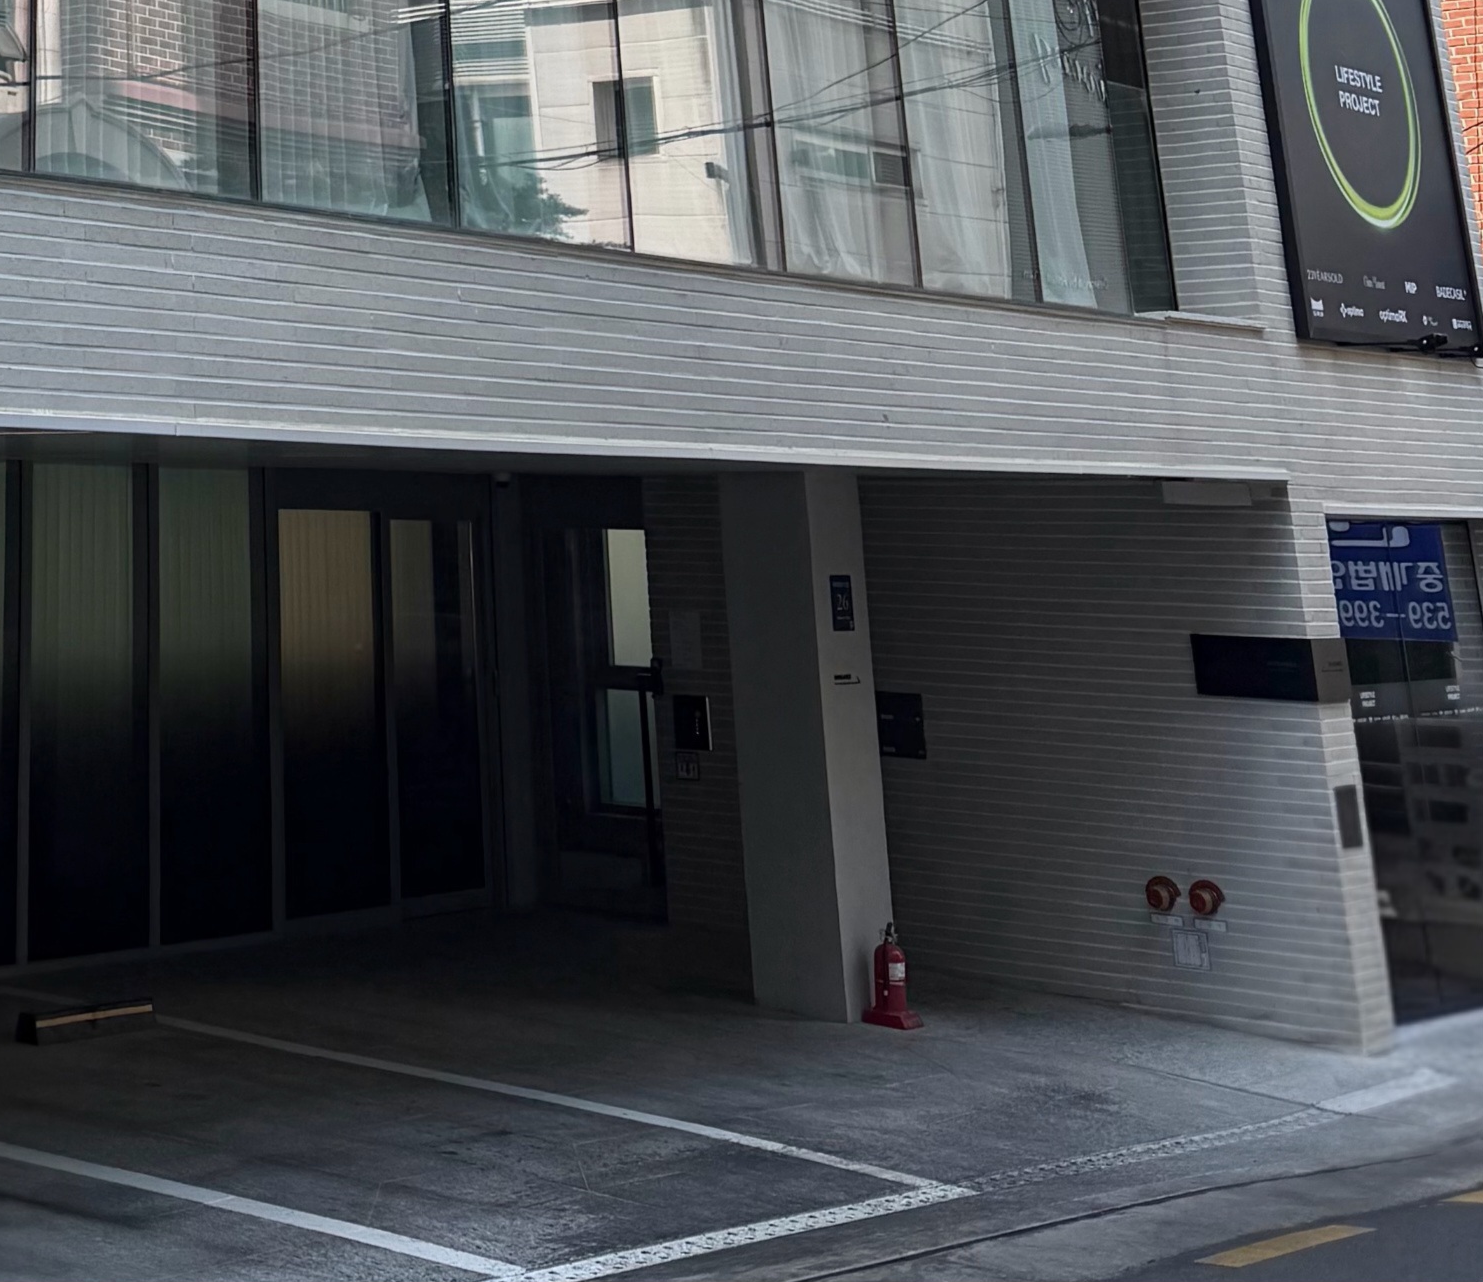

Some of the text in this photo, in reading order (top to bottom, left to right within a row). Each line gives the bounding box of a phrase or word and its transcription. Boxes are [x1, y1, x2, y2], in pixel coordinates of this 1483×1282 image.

[1334, 64, 1383, 93] LIFESTYLE
[1338, 90, 1380, 116] PROJECT
[836, 593, 849, 611] 26
